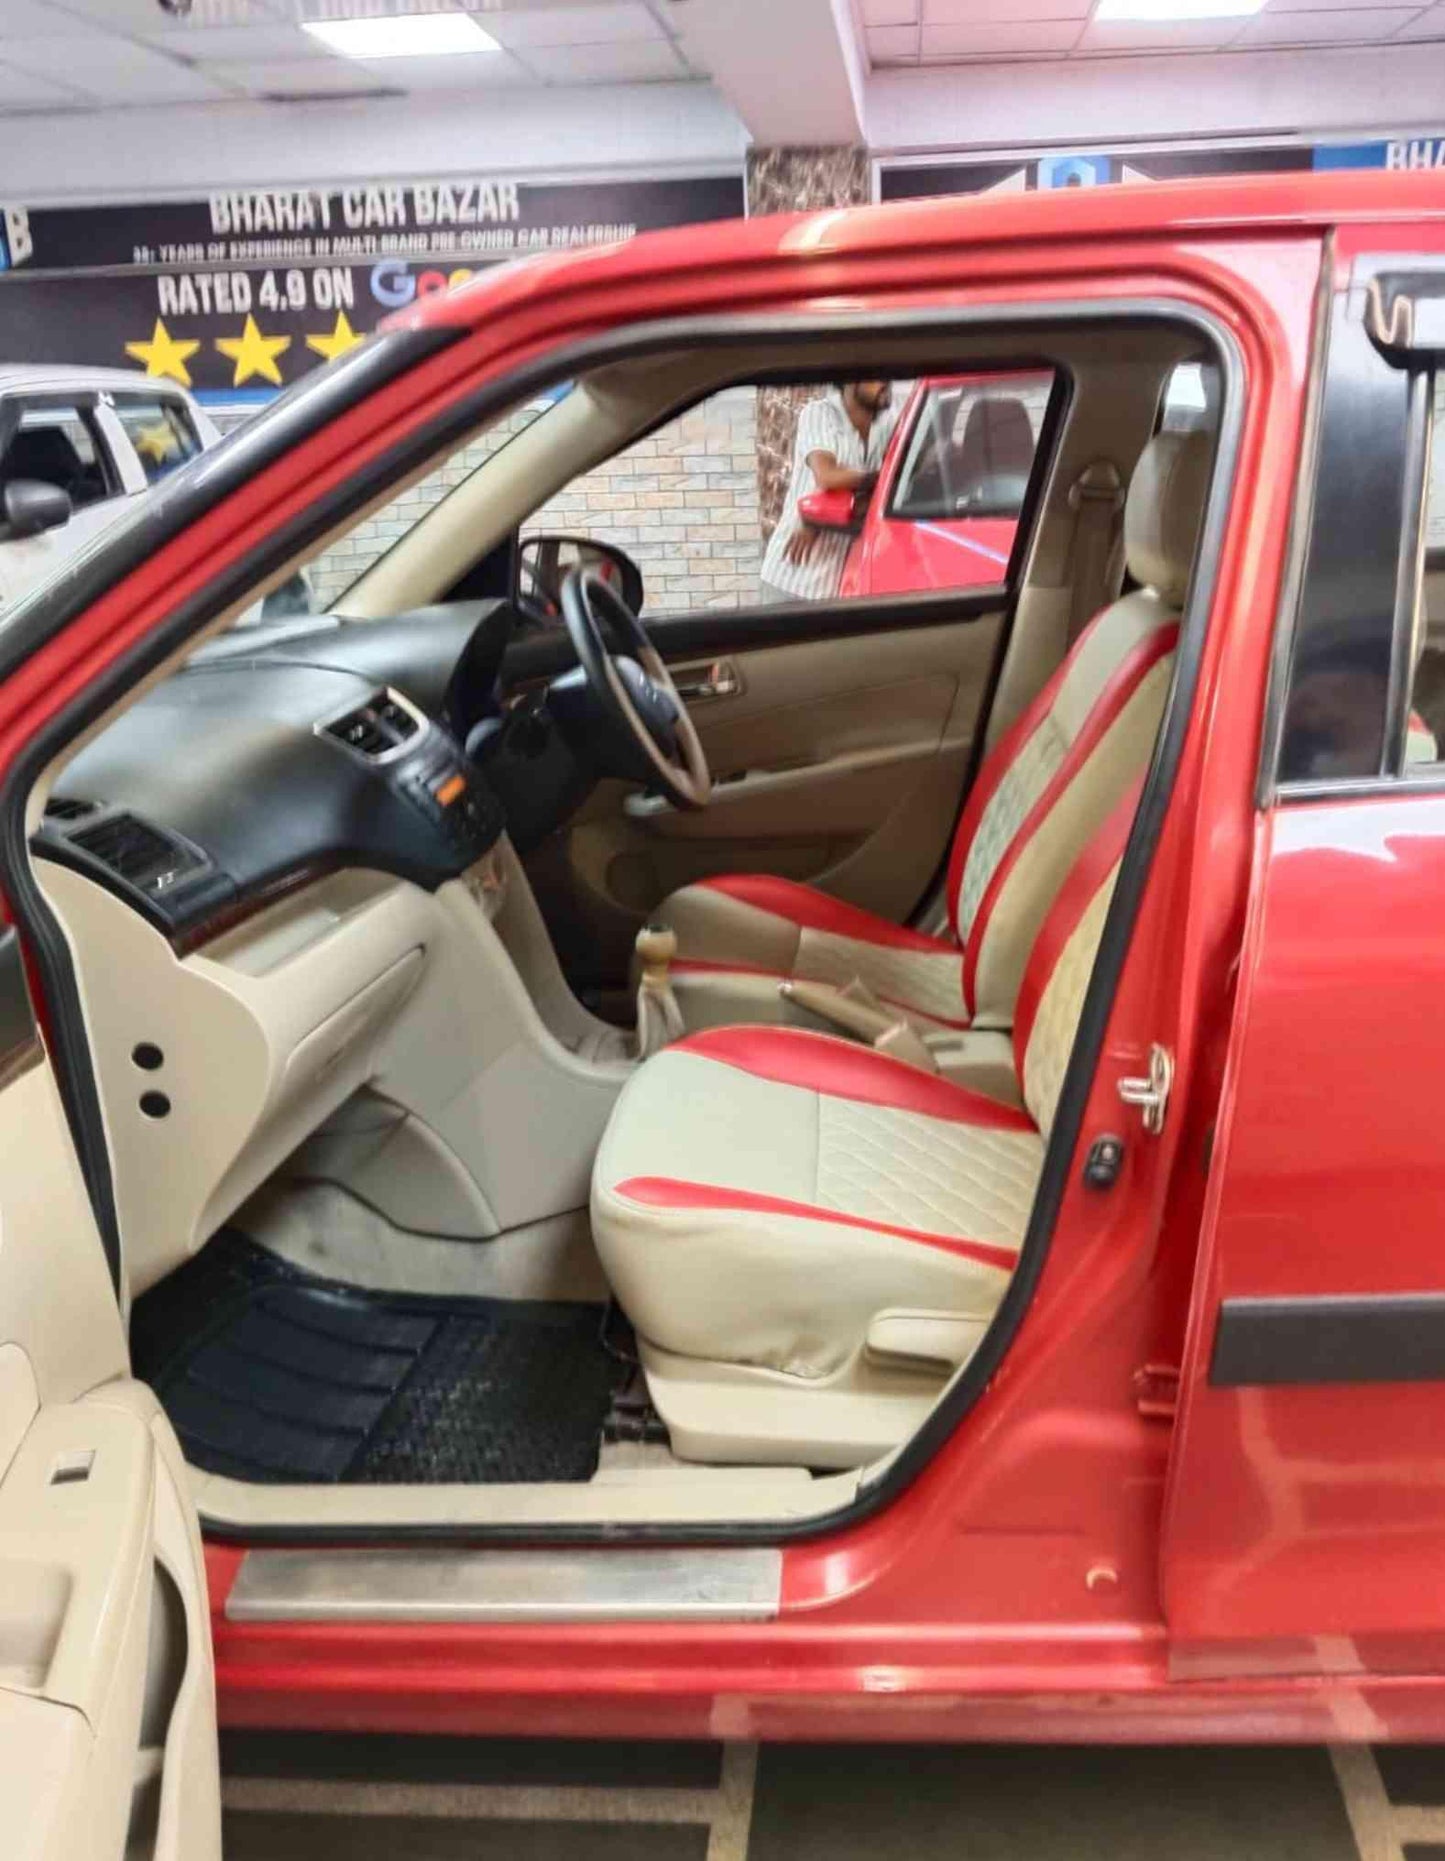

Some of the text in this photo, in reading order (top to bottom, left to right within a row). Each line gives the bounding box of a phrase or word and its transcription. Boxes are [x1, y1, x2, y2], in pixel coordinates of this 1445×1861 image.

[209, 182, 520, 235] BHARAT CAR BAZAR
[157, 272, 251, 316] RATED
[258, 269, 306, 313] 4.9
[313, 266, 355, 311] ON
